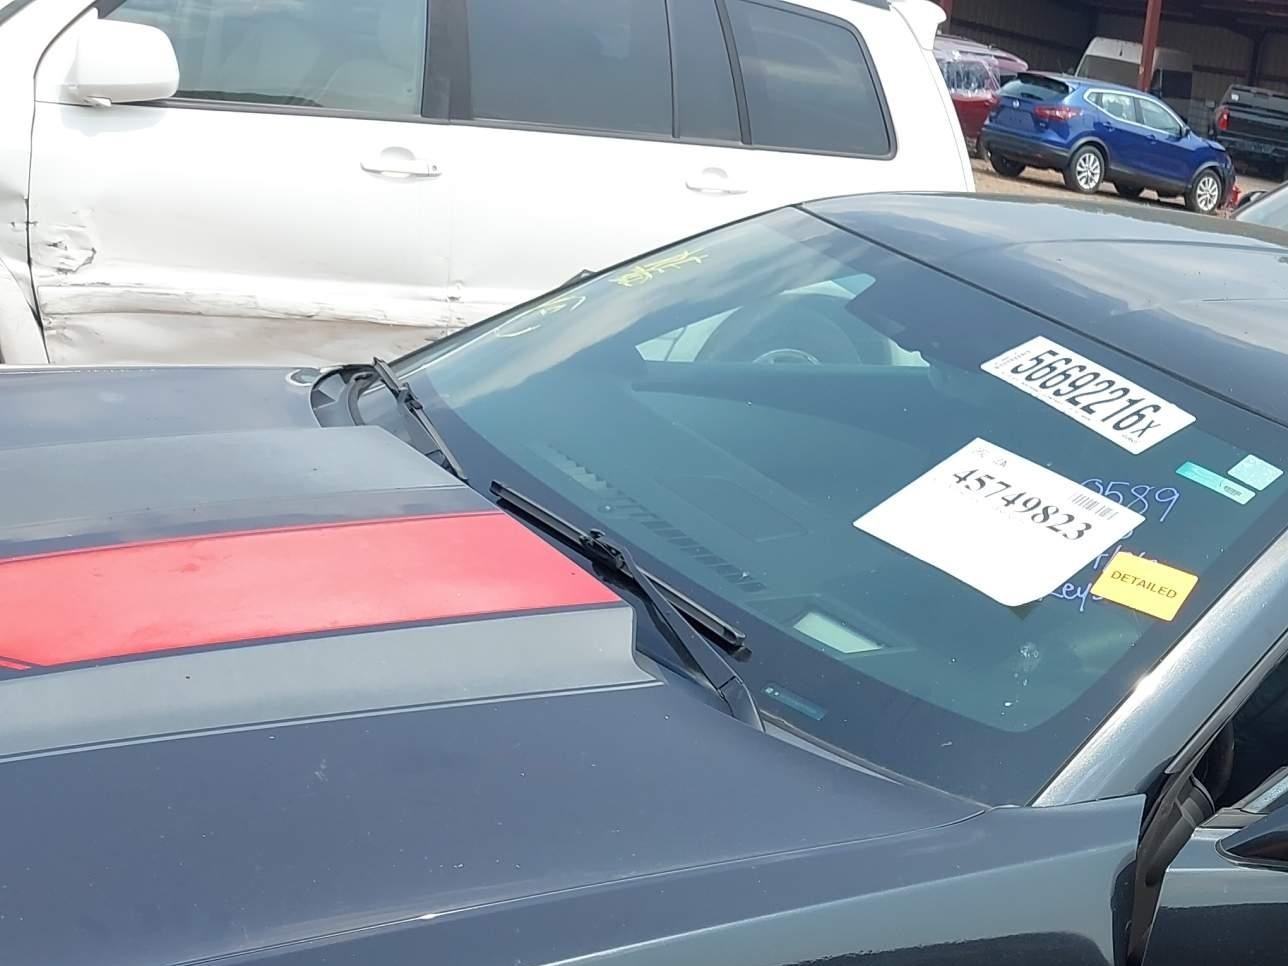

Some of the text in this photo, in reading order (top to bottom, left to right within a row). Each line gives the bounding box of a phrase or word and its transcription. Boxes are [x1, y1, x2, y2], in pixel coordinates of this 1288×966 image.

[952, 468, 1093, 540] 45749823
[1050, 581, 1104, 612] ey
[1110, 570, 1178, 600] DETAILED
